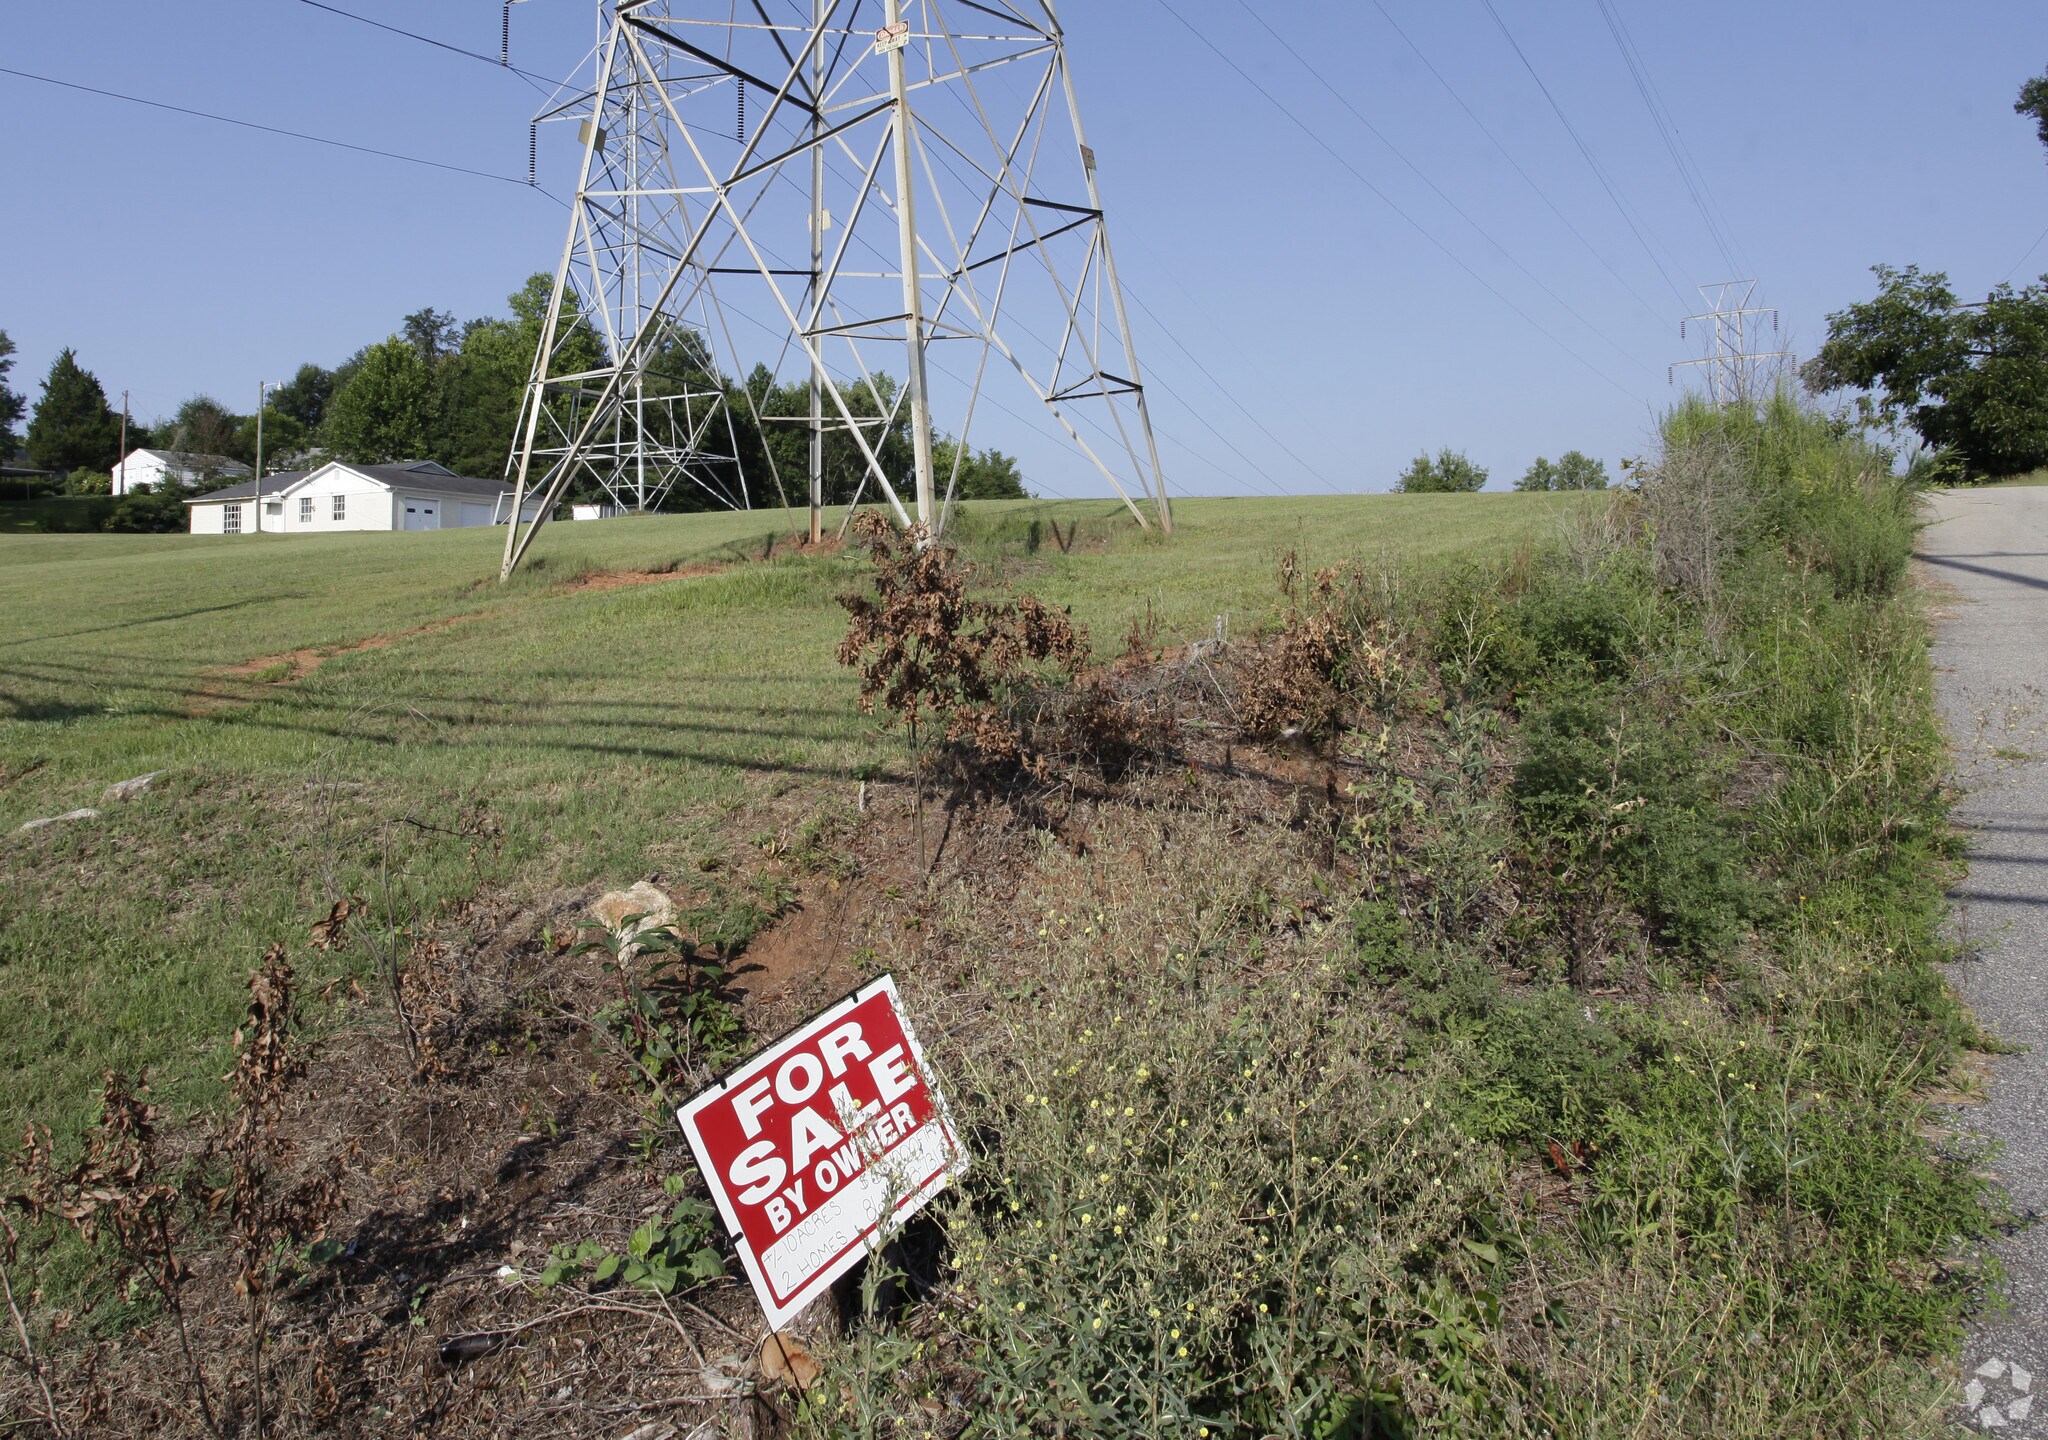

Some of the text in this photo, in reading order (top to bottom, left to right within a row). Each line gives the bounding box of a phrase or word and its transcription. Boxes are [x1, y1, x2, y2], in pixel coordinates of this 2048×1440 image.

[729, 1043, 918, 1205] SALE
[731, 1022, 873, 1140] FOR
[764, 1102, 918, 1234] BY OWNER
[782, 1231, 848, 1292] 2 HOMES
